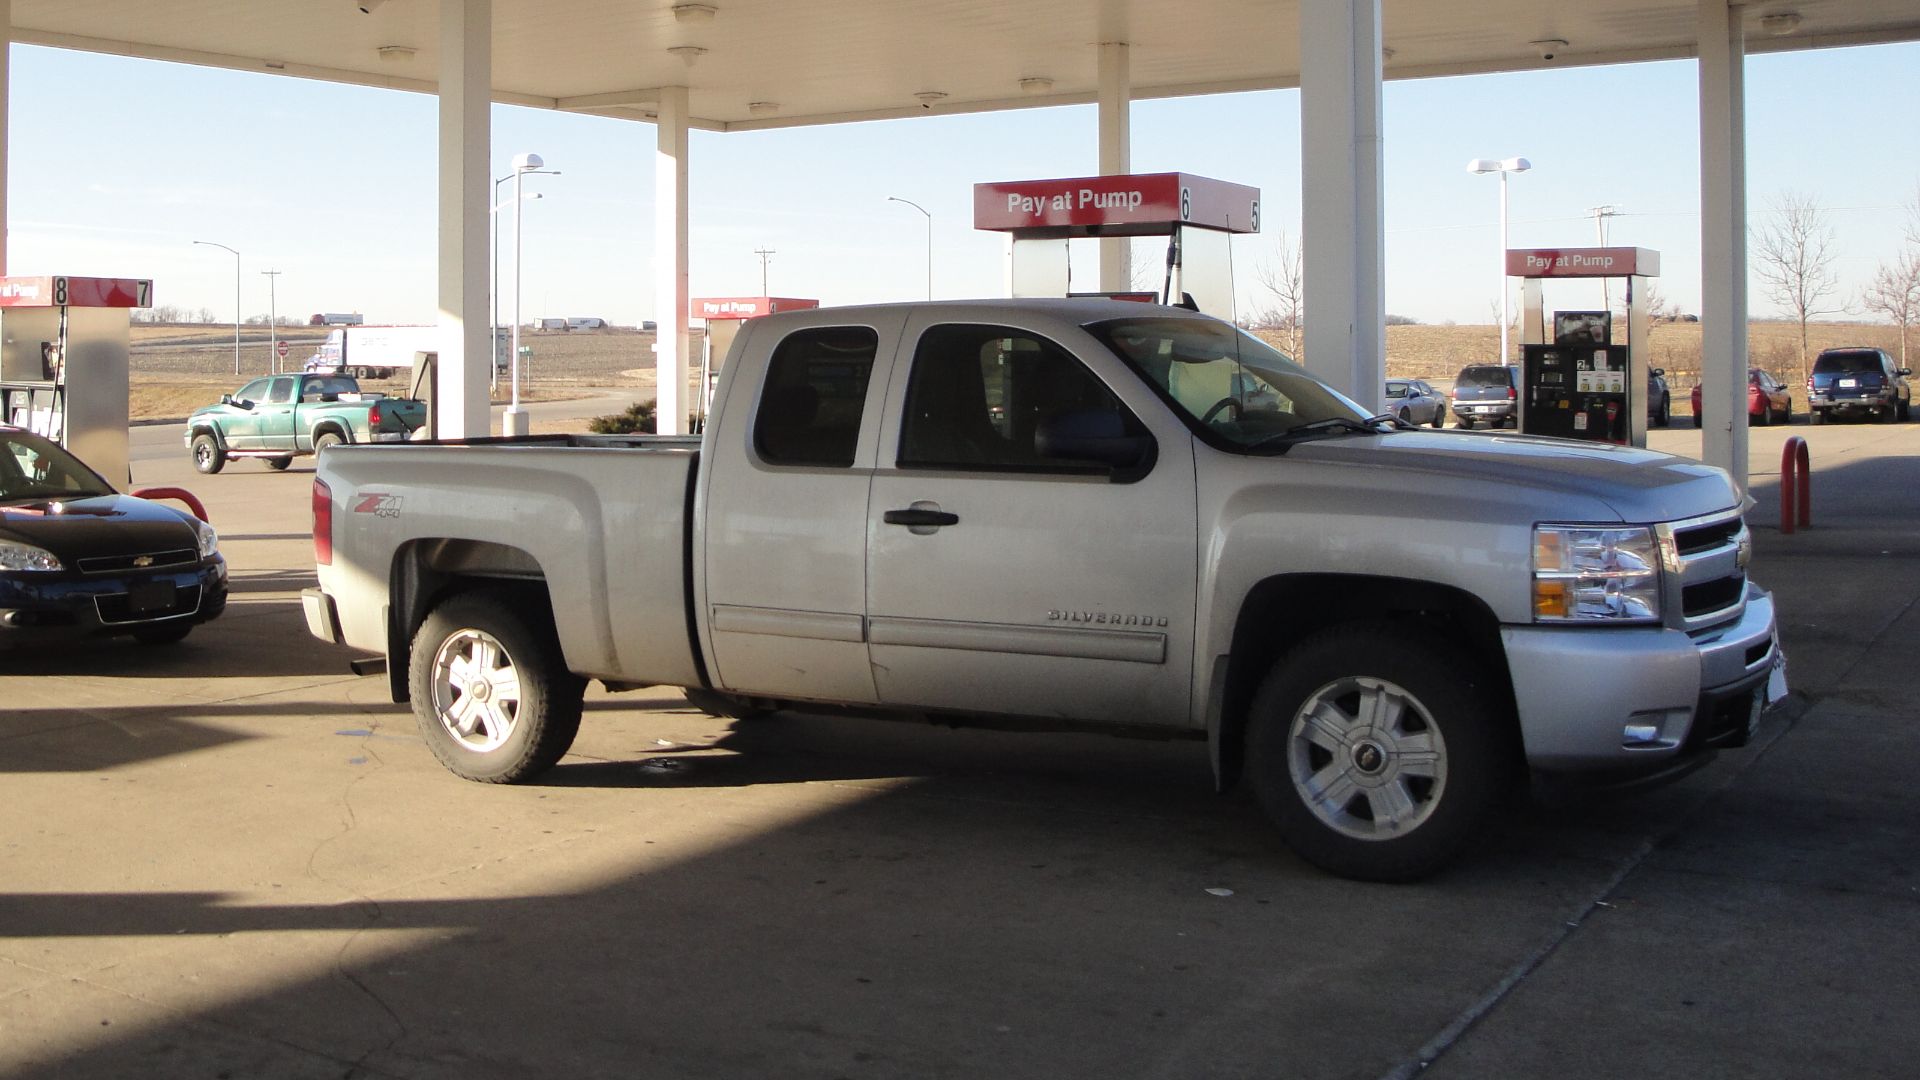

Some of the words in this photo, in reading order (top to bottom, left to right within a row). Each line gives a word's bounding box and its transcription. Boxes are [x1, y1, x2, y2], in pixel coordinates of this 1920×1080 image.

[1008, 193, 1045, 216] Pay
[1052, 191, 1072, 210] at
[1079, 189, 1142, 212] Pump
[1182, 188, 1190, 220] 6
[1251, 201, 1258, 231] 5
[1527, 255, 1552, 269] Pay
[1556, 255, 1569, 267] at
[1573, 254, 1613, 269] Pump
[56, 277, 67, 304] 8
[138, 281, 149, 306] 7
[703, 302, 720, 315] Pay
[720, 302, 730, 313] at
[731, 301, 756, 314] Pump
[1578, 361, 1585, 370] 2
[1048, 609, 1168, 627] SILVERADO
